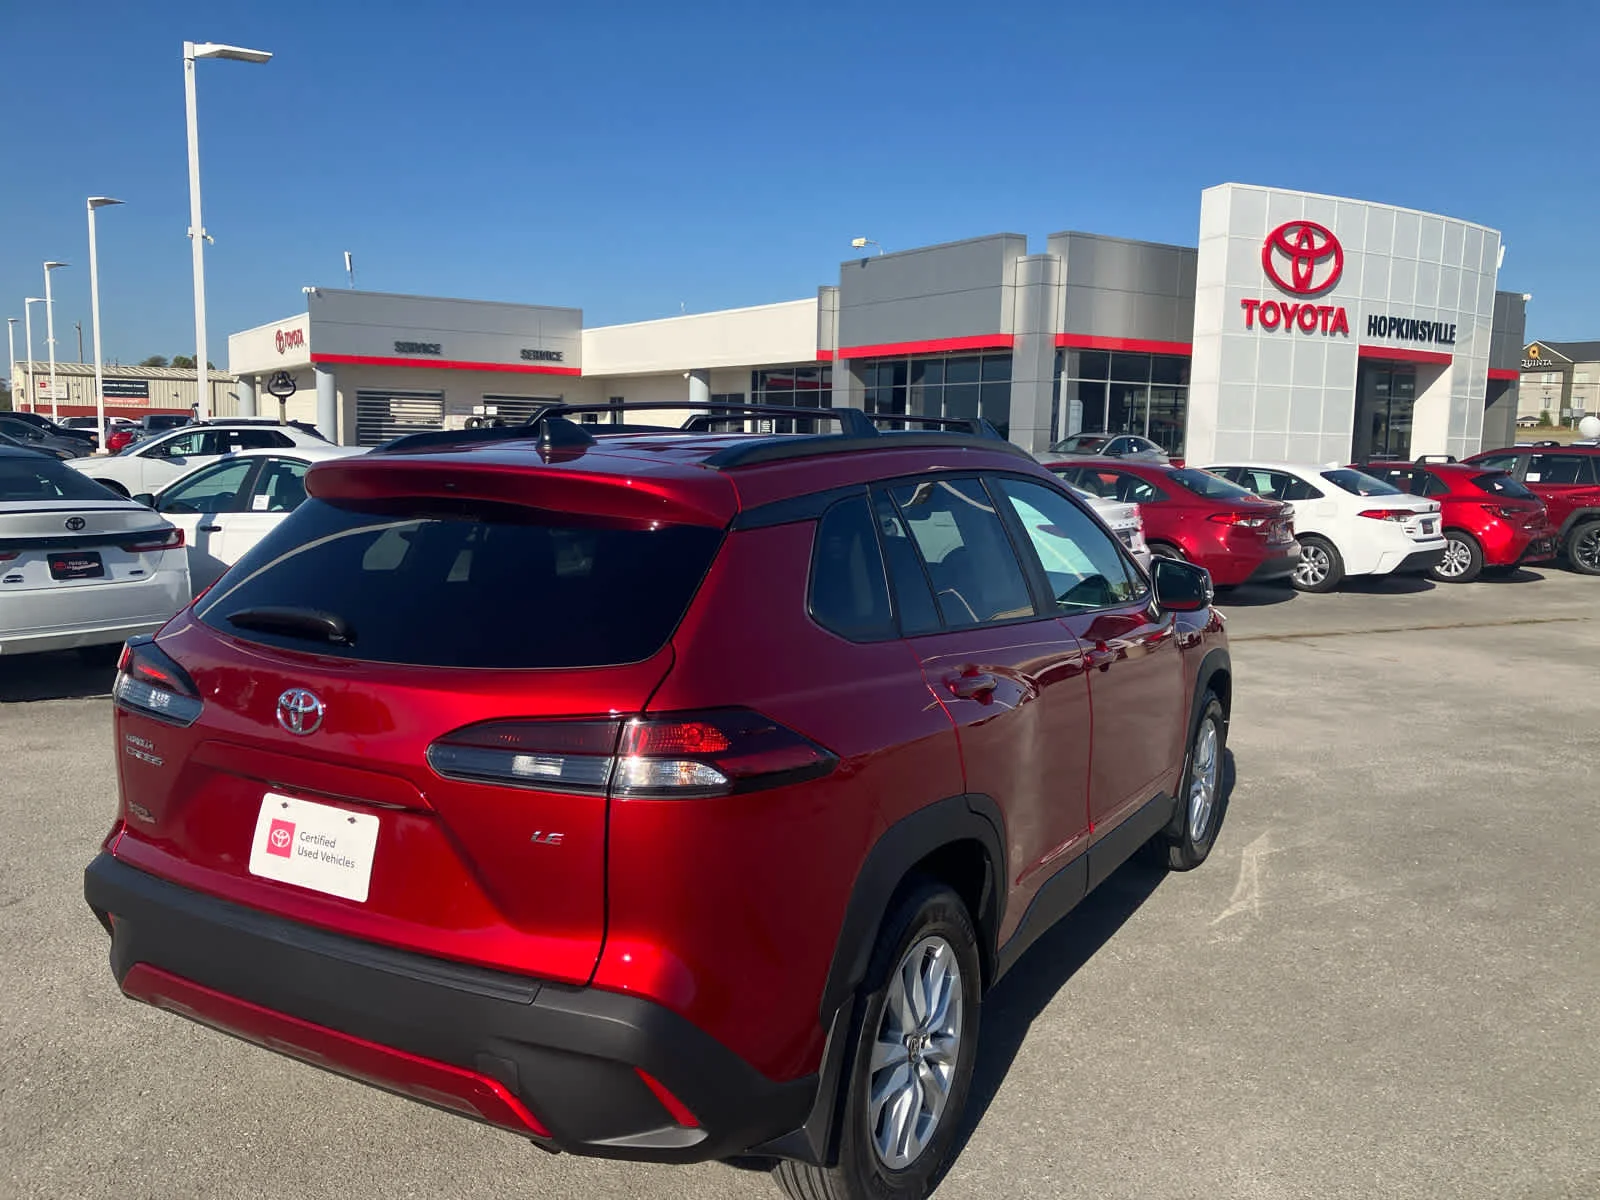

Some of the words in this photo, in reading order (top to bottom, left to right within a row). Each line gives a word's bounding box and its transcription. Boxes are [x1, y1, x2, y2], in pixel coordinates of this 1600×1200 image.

[1241, 298, 1349, 337] TOYOTA
[1367, 313, 1457, 345] HOPKINSVILLE
[284, 328, 304, 349] TOYOTA
[394, 340, 442, 355] SERVICE
[520, 348, 564, 362] SERVICE
[1521, 359, 1553, 369] QUINTA
[299, 832, 336, 848] Certified
[531, 831, 564, 845] LE
[297, 846, 318, 859] Used
[320, 851, 356, 869] Vehicles
